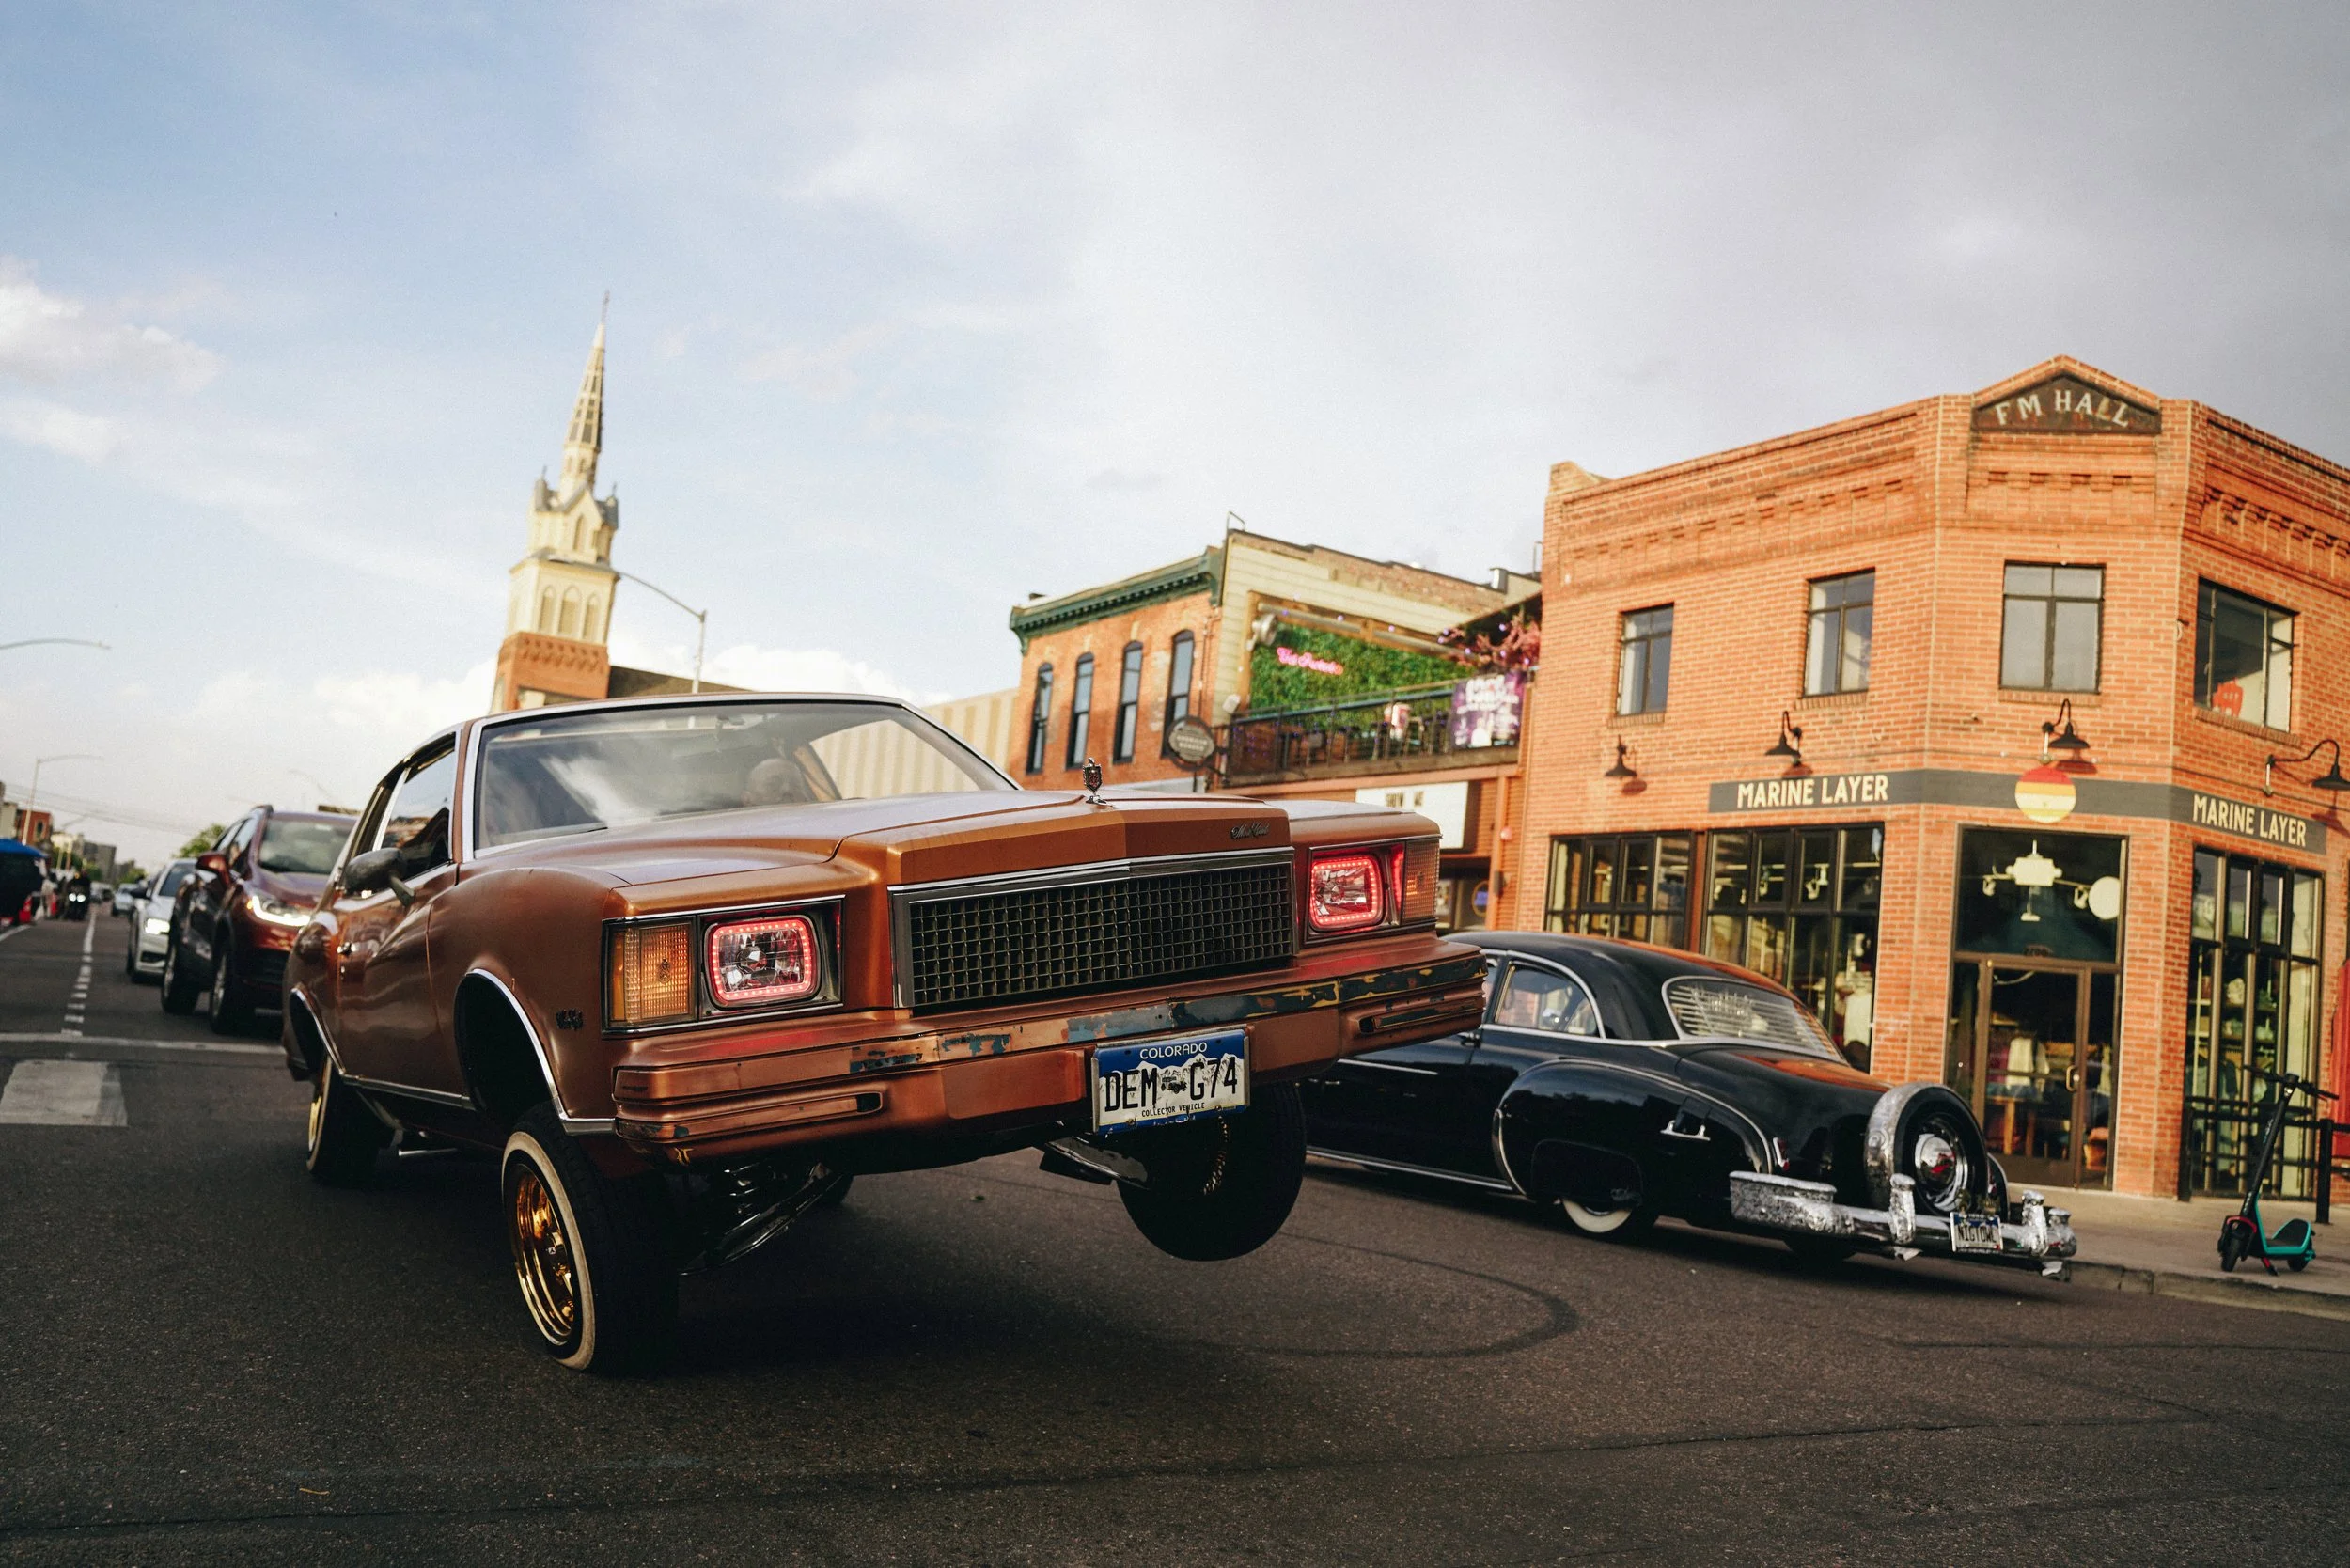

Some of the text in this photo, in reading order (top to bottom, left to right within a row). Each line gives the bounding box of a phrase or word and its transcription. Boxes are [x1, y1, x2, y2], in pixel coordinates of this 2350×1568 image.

[2054, 389, 2129, 428] HALL
[1737, 774, 1889, 808] MARINE LAYER
[2192, 793, 2306, 847] MARINE LAYER
[1139, 1042, 1208, 1058] COLORADO
[1141, 1102, 1205, 1117] COLLECTOR VEHICLE
